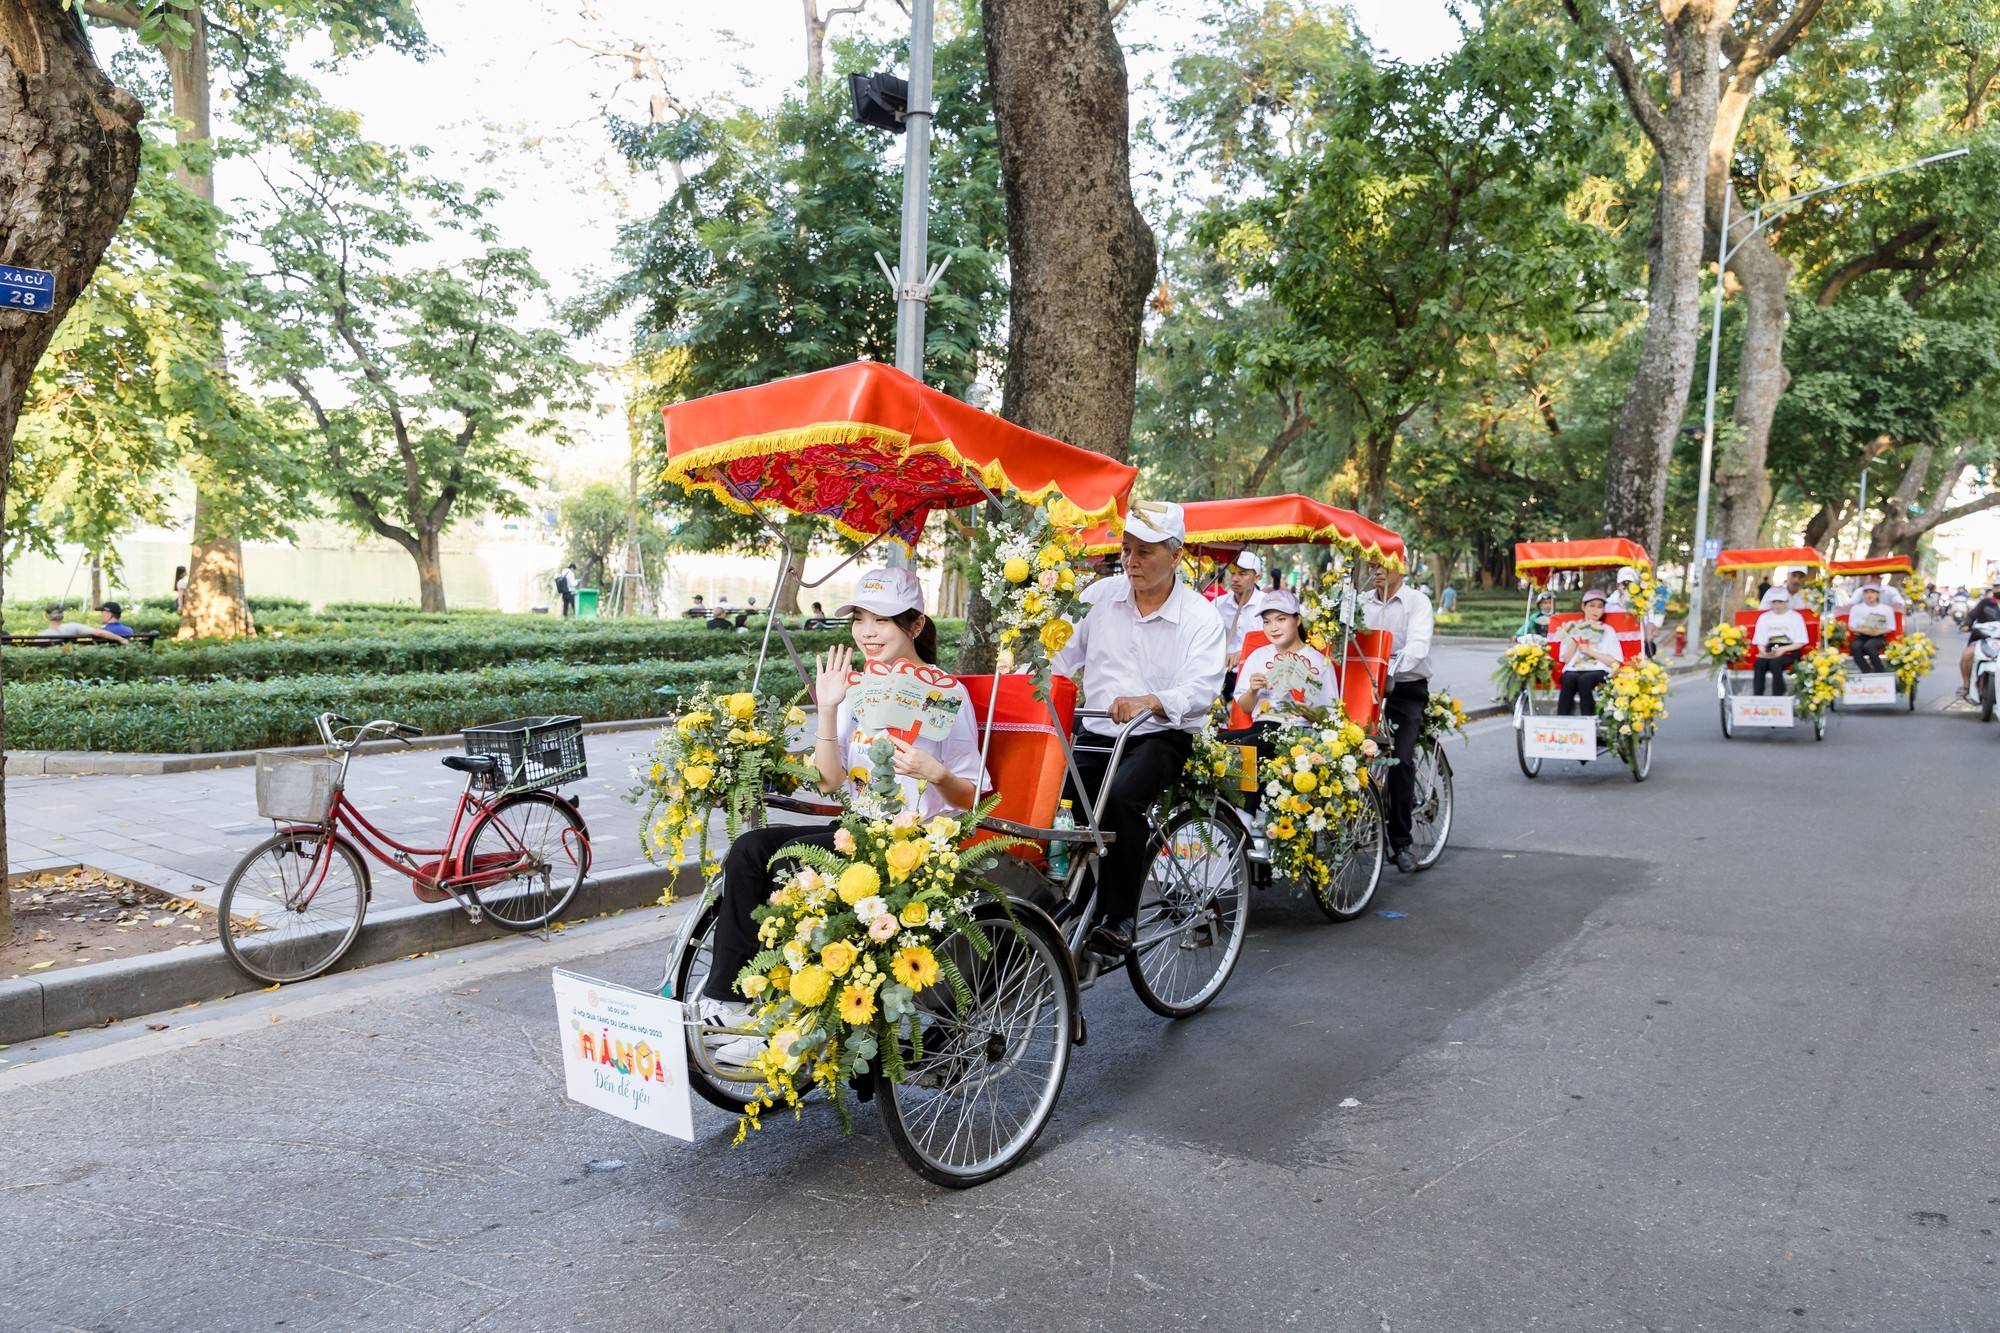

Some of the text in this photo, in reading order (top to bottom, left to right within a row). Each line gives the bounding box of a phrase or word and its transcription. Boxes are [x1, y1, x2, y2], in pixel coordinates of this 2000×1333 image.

[4, 270, 45, 285] XÀ CỪ
[10, 291, 35, 306] 28
